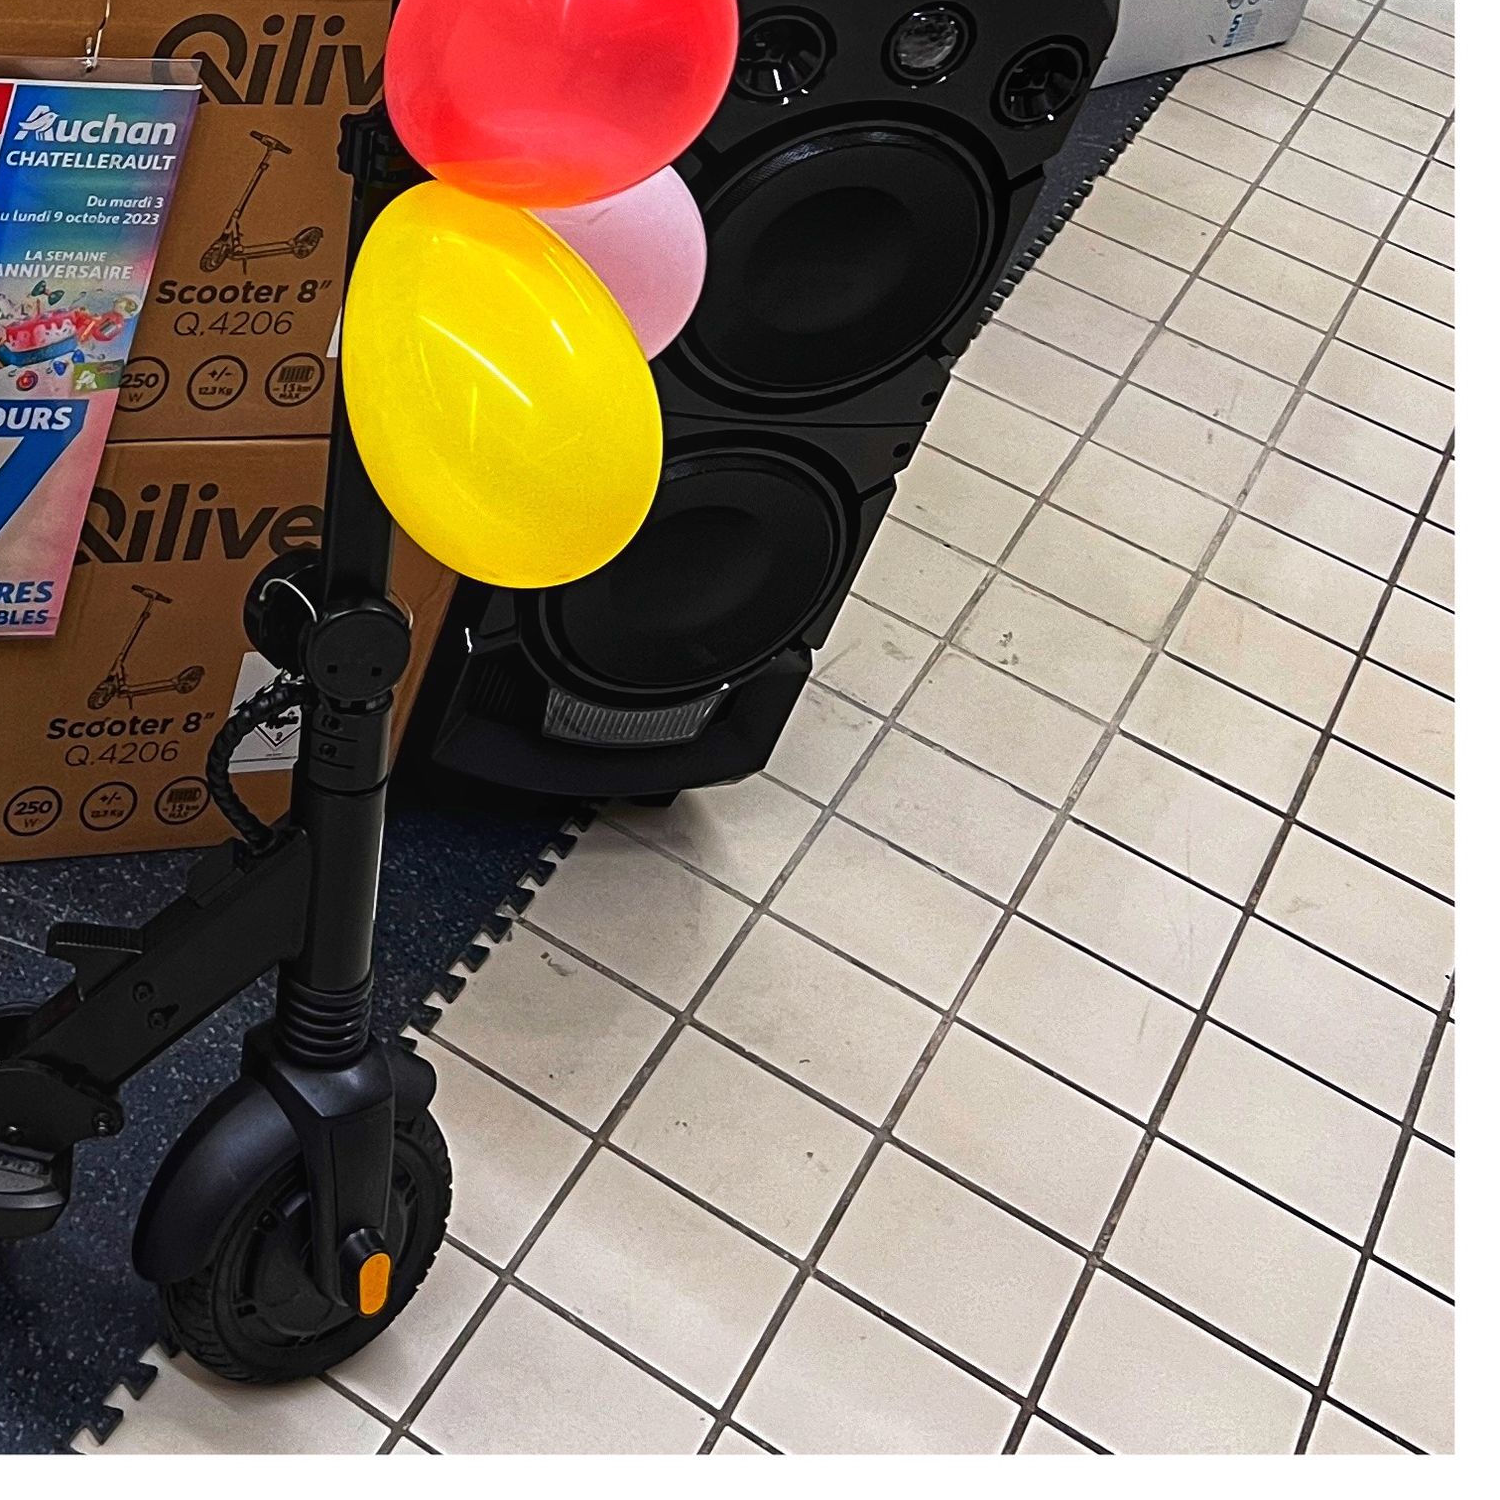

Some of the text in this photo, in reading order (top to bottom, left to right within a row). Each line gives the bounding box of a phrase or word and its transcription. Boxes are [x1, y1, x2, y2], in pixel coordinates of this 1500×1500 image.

[152, 13, 388, 106] Qiliv
[13, 104, 177, 146] Auchan
[5, 150, 176, 172] CHATELLERAULT
[86, 195, 164, 209] Du mardi 3
[12, 209, 51, 222] lundi
[53, 211, 63, 223] 9
[65, 211, 120, 225] octobre
[122, 212, 160, 226] 2023
[24, 250, 108, 263] LA SEMAINE
[155, 279, 289, 305] Scooter
[173, 310, 294, 337] Q.4206
[121, 372, 159, 389] 250
[45, 713, 173, 740] Scooter
[64, 739, 180, 768] Q.4206
[14, 801, 52, 816] 250
